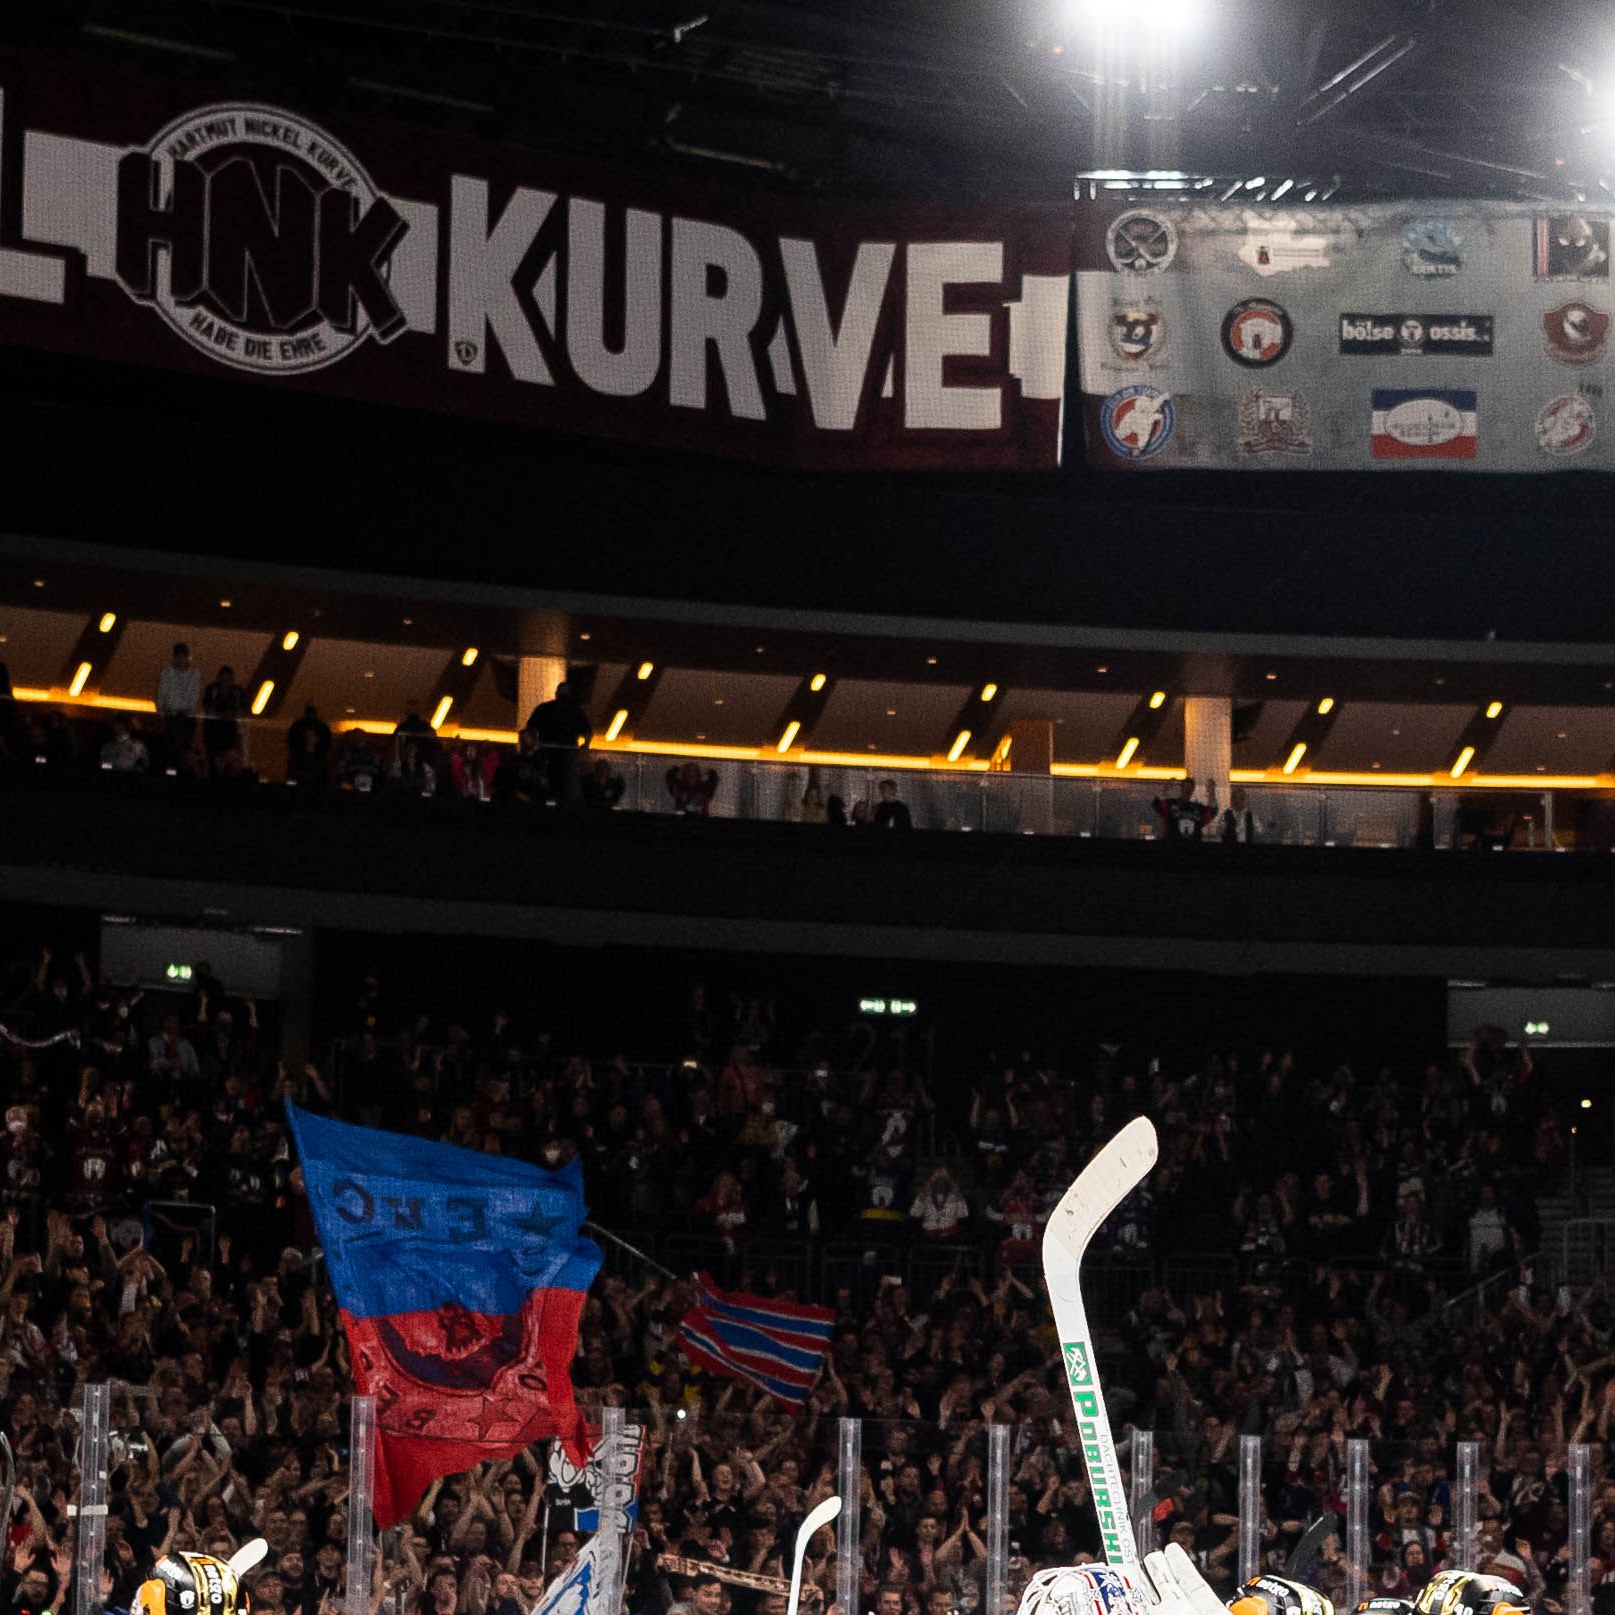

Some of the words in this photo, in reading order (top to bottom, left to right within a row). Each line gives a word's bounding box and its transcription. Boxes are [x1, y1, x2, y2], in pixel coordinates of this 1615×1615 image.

[244, 115, 302, 150] NICKEL
[308, 142, 359, 190] KURVE
[116, 152, 409, 345] HNK
[448, 174, 1004, 431] KURVE
[244, 338, 273, 359] DIE
[279, 332, 327, 360] EHRE
[1074, 1390, 1122, 1565] POBURSKI
